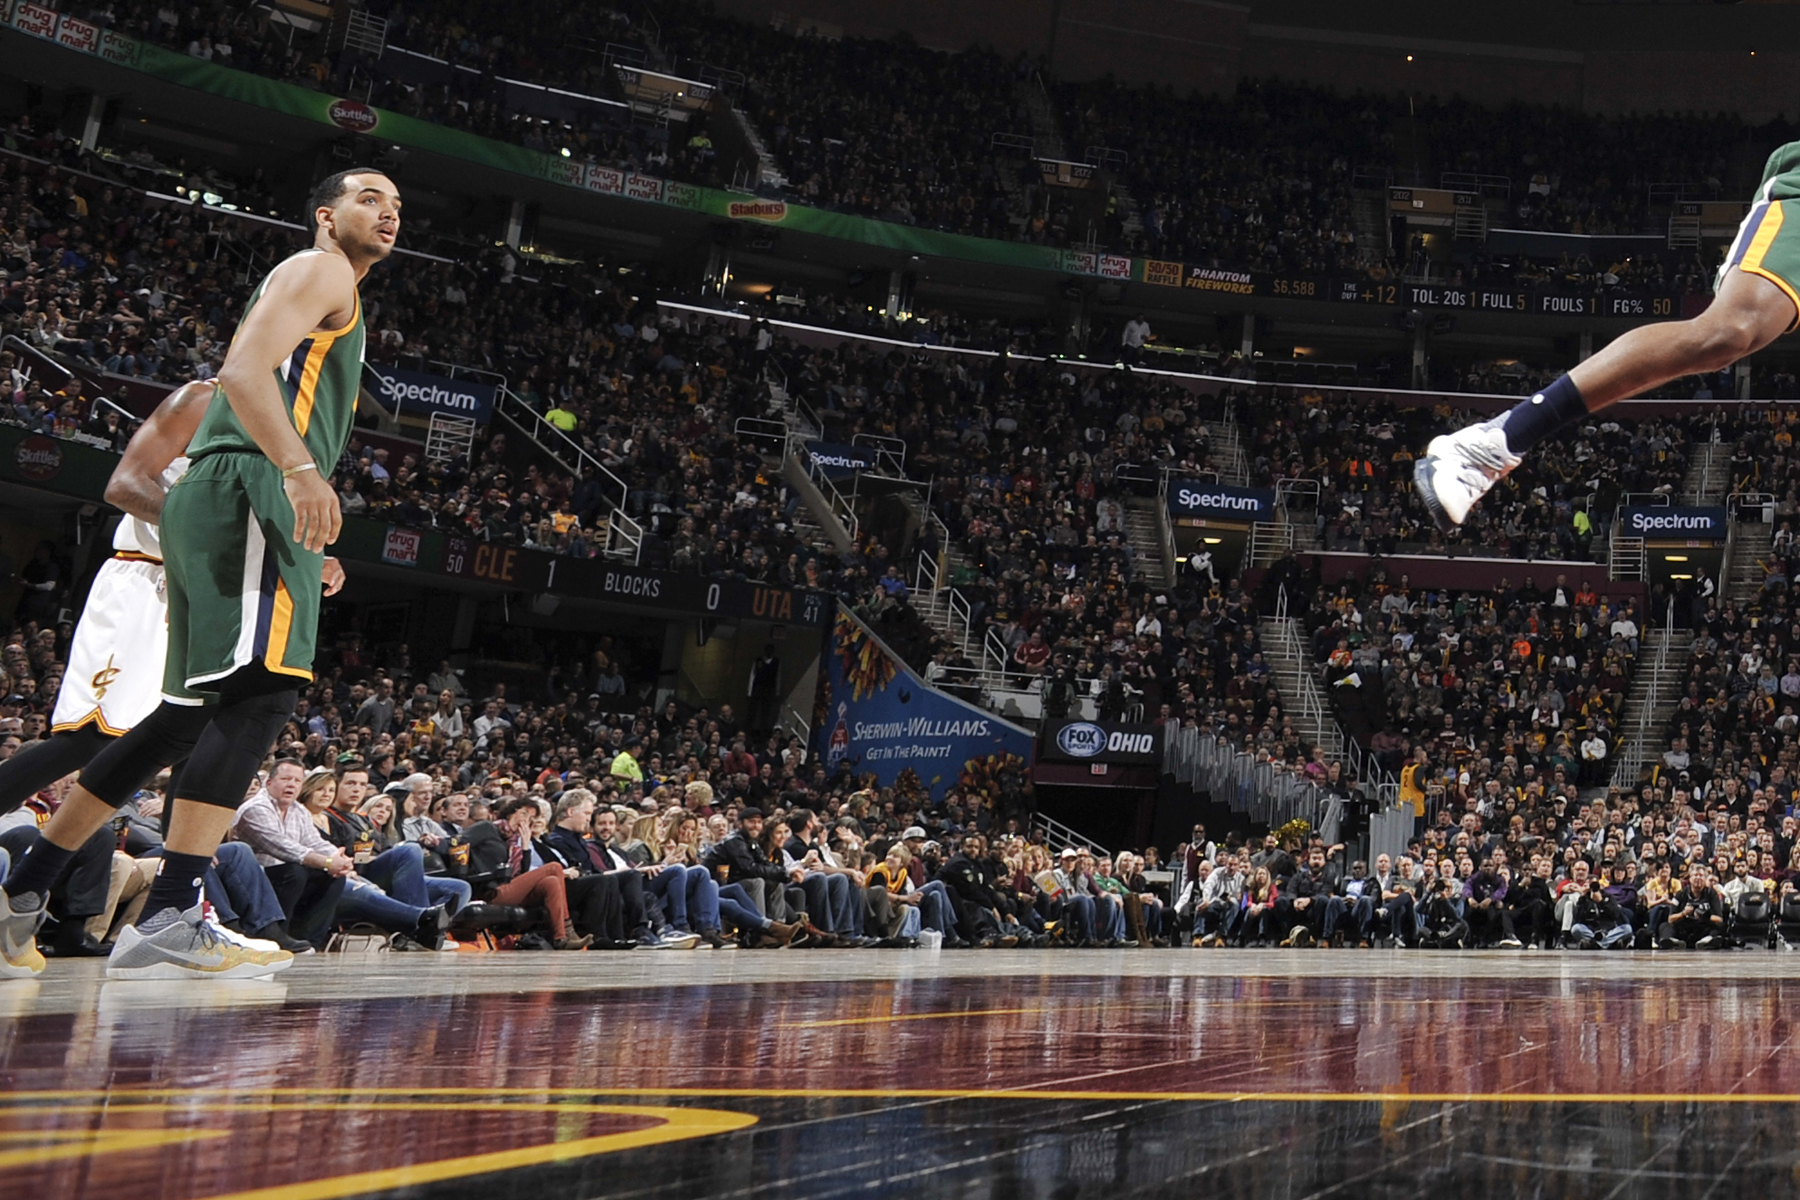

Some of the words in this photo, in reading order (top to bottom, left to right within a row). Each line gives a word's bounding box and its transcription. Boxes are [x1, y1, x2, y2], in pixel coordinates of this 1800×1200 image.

[18, 0, 52, 26] drug
[16, 19, 53, 39] mart
[333, 106, 374, 122] Skittles
[589, 163, 618, 183] drug
[590, 179, 621, 193] mart
[1100, 254, 1127, 269] drug
[1148, 262, 1179, 275] 50/50
[1102, 265, 1131, 277] mart
[1192, 267, 1251, 284] PHANTOM
[1185, 277, 1255, 295] FIREWORKS
[1362, 285, 1396, 303] +12
[1411, 288, 1439, 305] TOL:
[1443, 290, 1466, 307] 20s
[1482, 292, 1514, 309] FULL
[1516, 294, 1526, 311] 5
[1543, 296, 1584, 313] FOULS
[1613, 299, 1644, 314] FG%
[1653, 298, 1672, 316] 50
[380, 376, 476, 410] Spectrum
[810, 451, 865, 469] Spectrum
[1179, 488, 1259, 511] Spectrum
[1632, 513, 1711, 533] Spectrum
[387, 530, 415, 549] drug
[387, 546, 417, 561] mart
[447, 554, 463, 573] 50
[474, 544, 514, 581] CLE
[547, 560, 556, 587] 1
[605, 572, 660, 597] BLOCKS
[706, 584, 719, 610] 0
[753, 587, 792, 619] UTA
[803, 605, 818, 622] 41
[1069, 729, 1095, 744] FOX
[1108, 731, 1154, 753] OHIO
